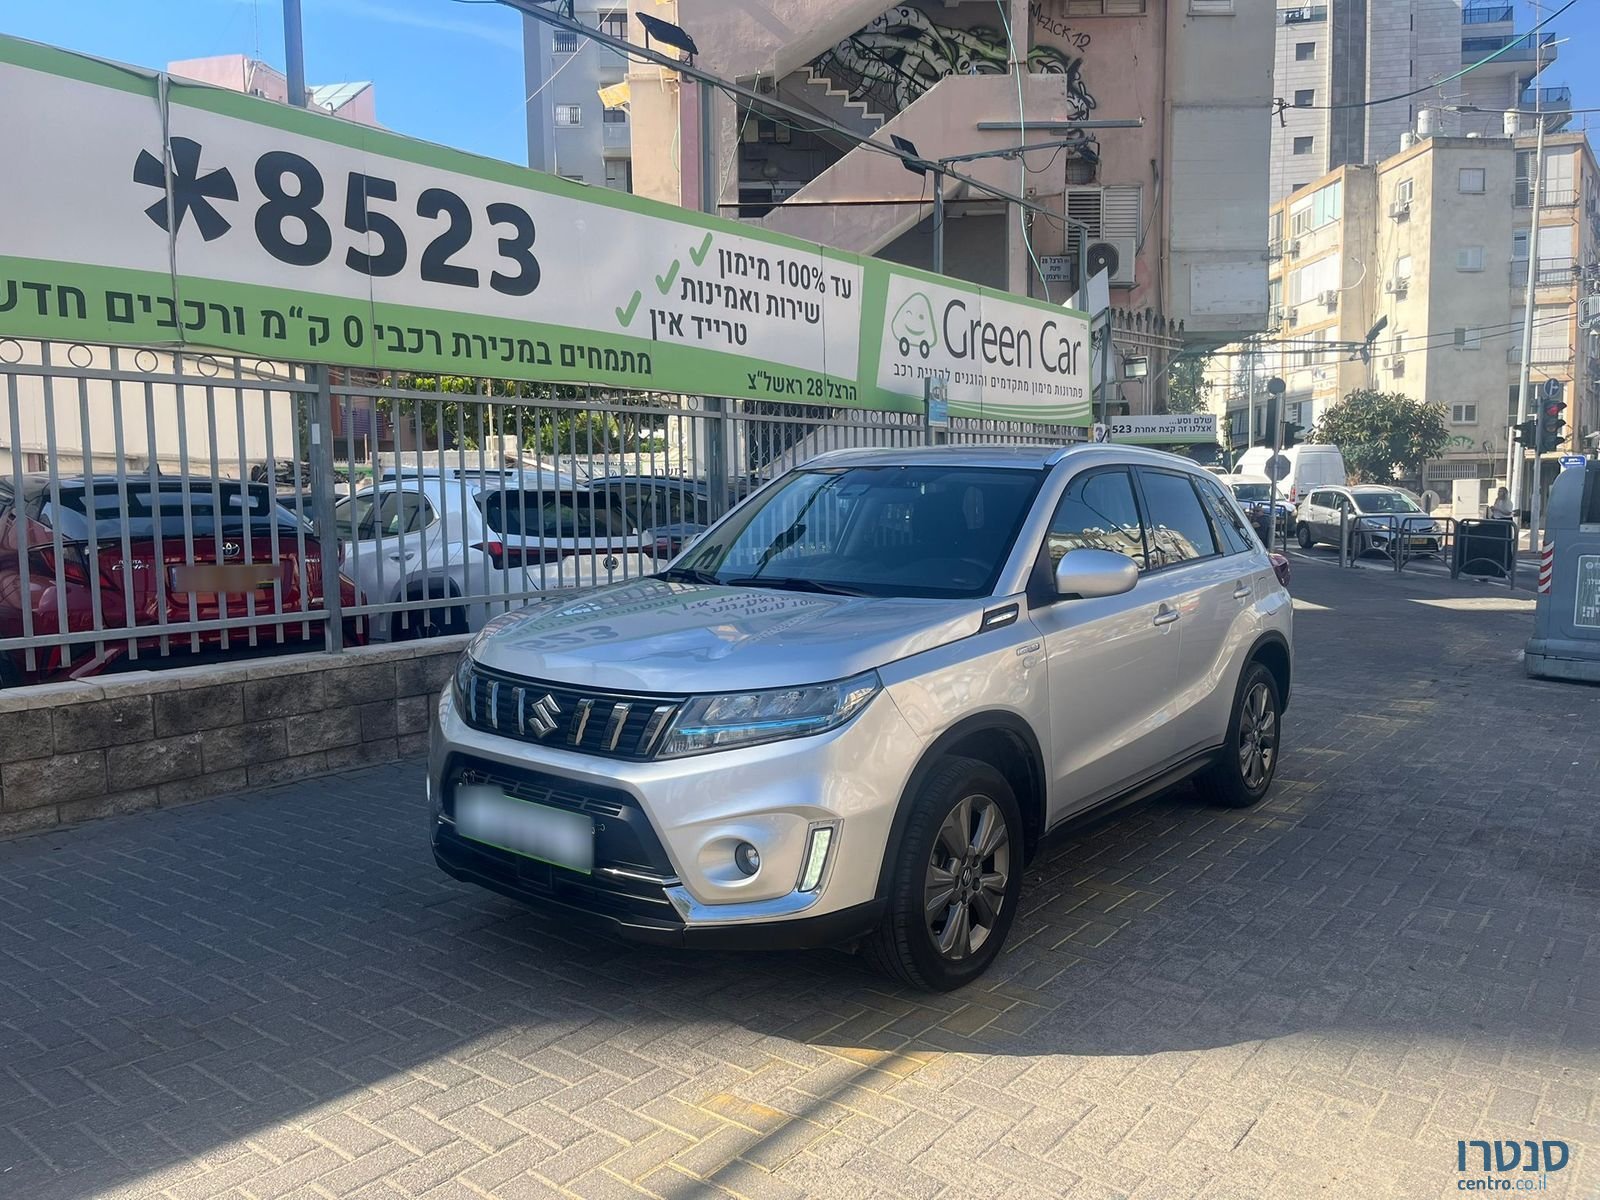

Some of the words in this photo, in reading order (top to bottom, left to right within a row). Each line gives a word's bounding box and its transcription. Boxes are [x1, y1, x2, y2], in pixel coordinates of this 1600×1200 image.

[718, 248, 770, 281] מימון
[776, 259, 826, 294] 100%
[830, 275, 852, 300] עד
[680, 276, 760, 314] ואמינות
[105, 290, 246, 336] ורכבים
[765, 293, 821, 325] שירות
[343, 315, 364, 349] 0
[650, 308, 684, 341] אין
[690, 314, 748, 346] טרייד
[373, 323, 443, 356] רכבי
[451, 332, 552, 366] במכירת
[942, 299, 1032, 370] Green
[1039, 320, 1082, 376] Car
[559, 343, 652, 376] מתמחים
[893, 362, 913, 378] רכב
[806, 377, 823, 397] 28
[826, 379, 857, 401] הרצל
[954, 371, 987, 387] והוגנים
[990, 377, 1029, 394] מתקדמים
[1031, 382, 1052, 397] מימון
[1054, 384, 1083, 399] פתרונות
[1111, 424, 1132, 434] 523
[1134, 426, 1156, 434] אחרת
[1158, 424, 1176, 434] קצת
[1177, 425, 1187, 433] זה
[1189, 424, 1212, 433] אצלנו
[1193, 416, 1212, 425] שלם
